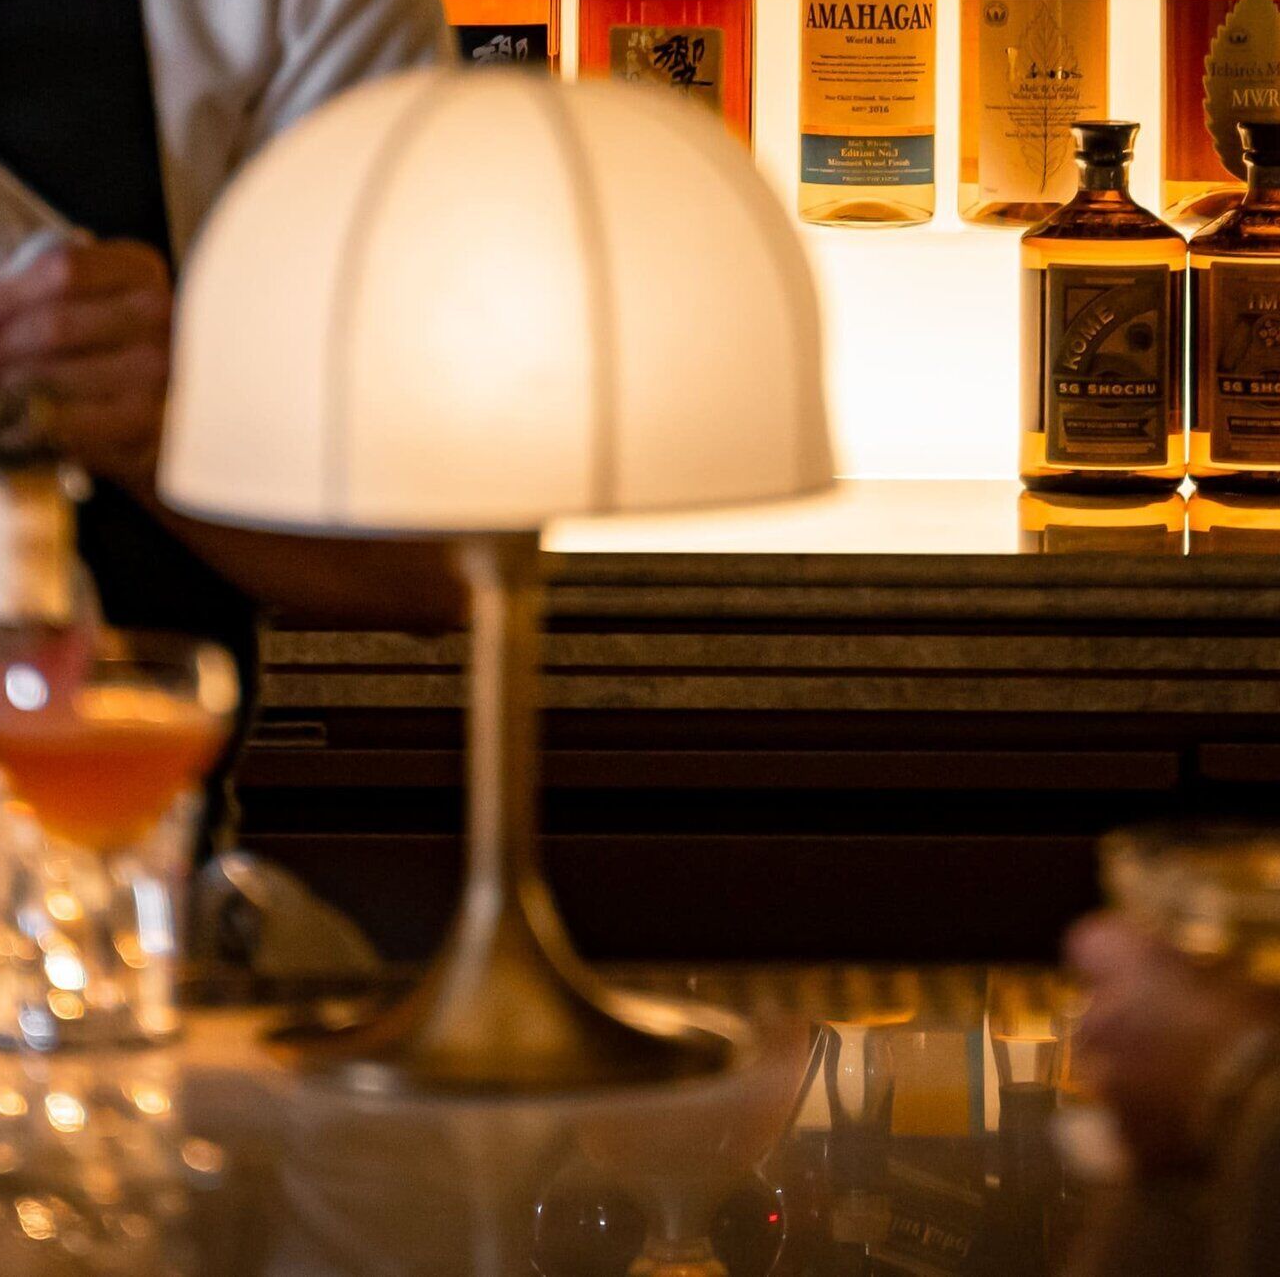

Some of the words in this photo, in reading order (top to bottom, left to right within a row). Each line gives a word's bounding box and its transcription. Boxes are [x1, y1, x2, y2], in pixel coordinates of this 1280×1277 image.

[806, 3, 932, 30] AMAHAGAN
[845, 36, 873, 44] World
[876, 36, 896, 44] Malt
[1232, 89, 1280, 107] MWR
[841, 148, 876, 157] Edition
[1063, 305, 1115, 371] KOME
[1059, 382, 1081, 393] SG
[1087, 383, 1157, 395] SHOCHU
[1222, 381, 1244, 392] SG
